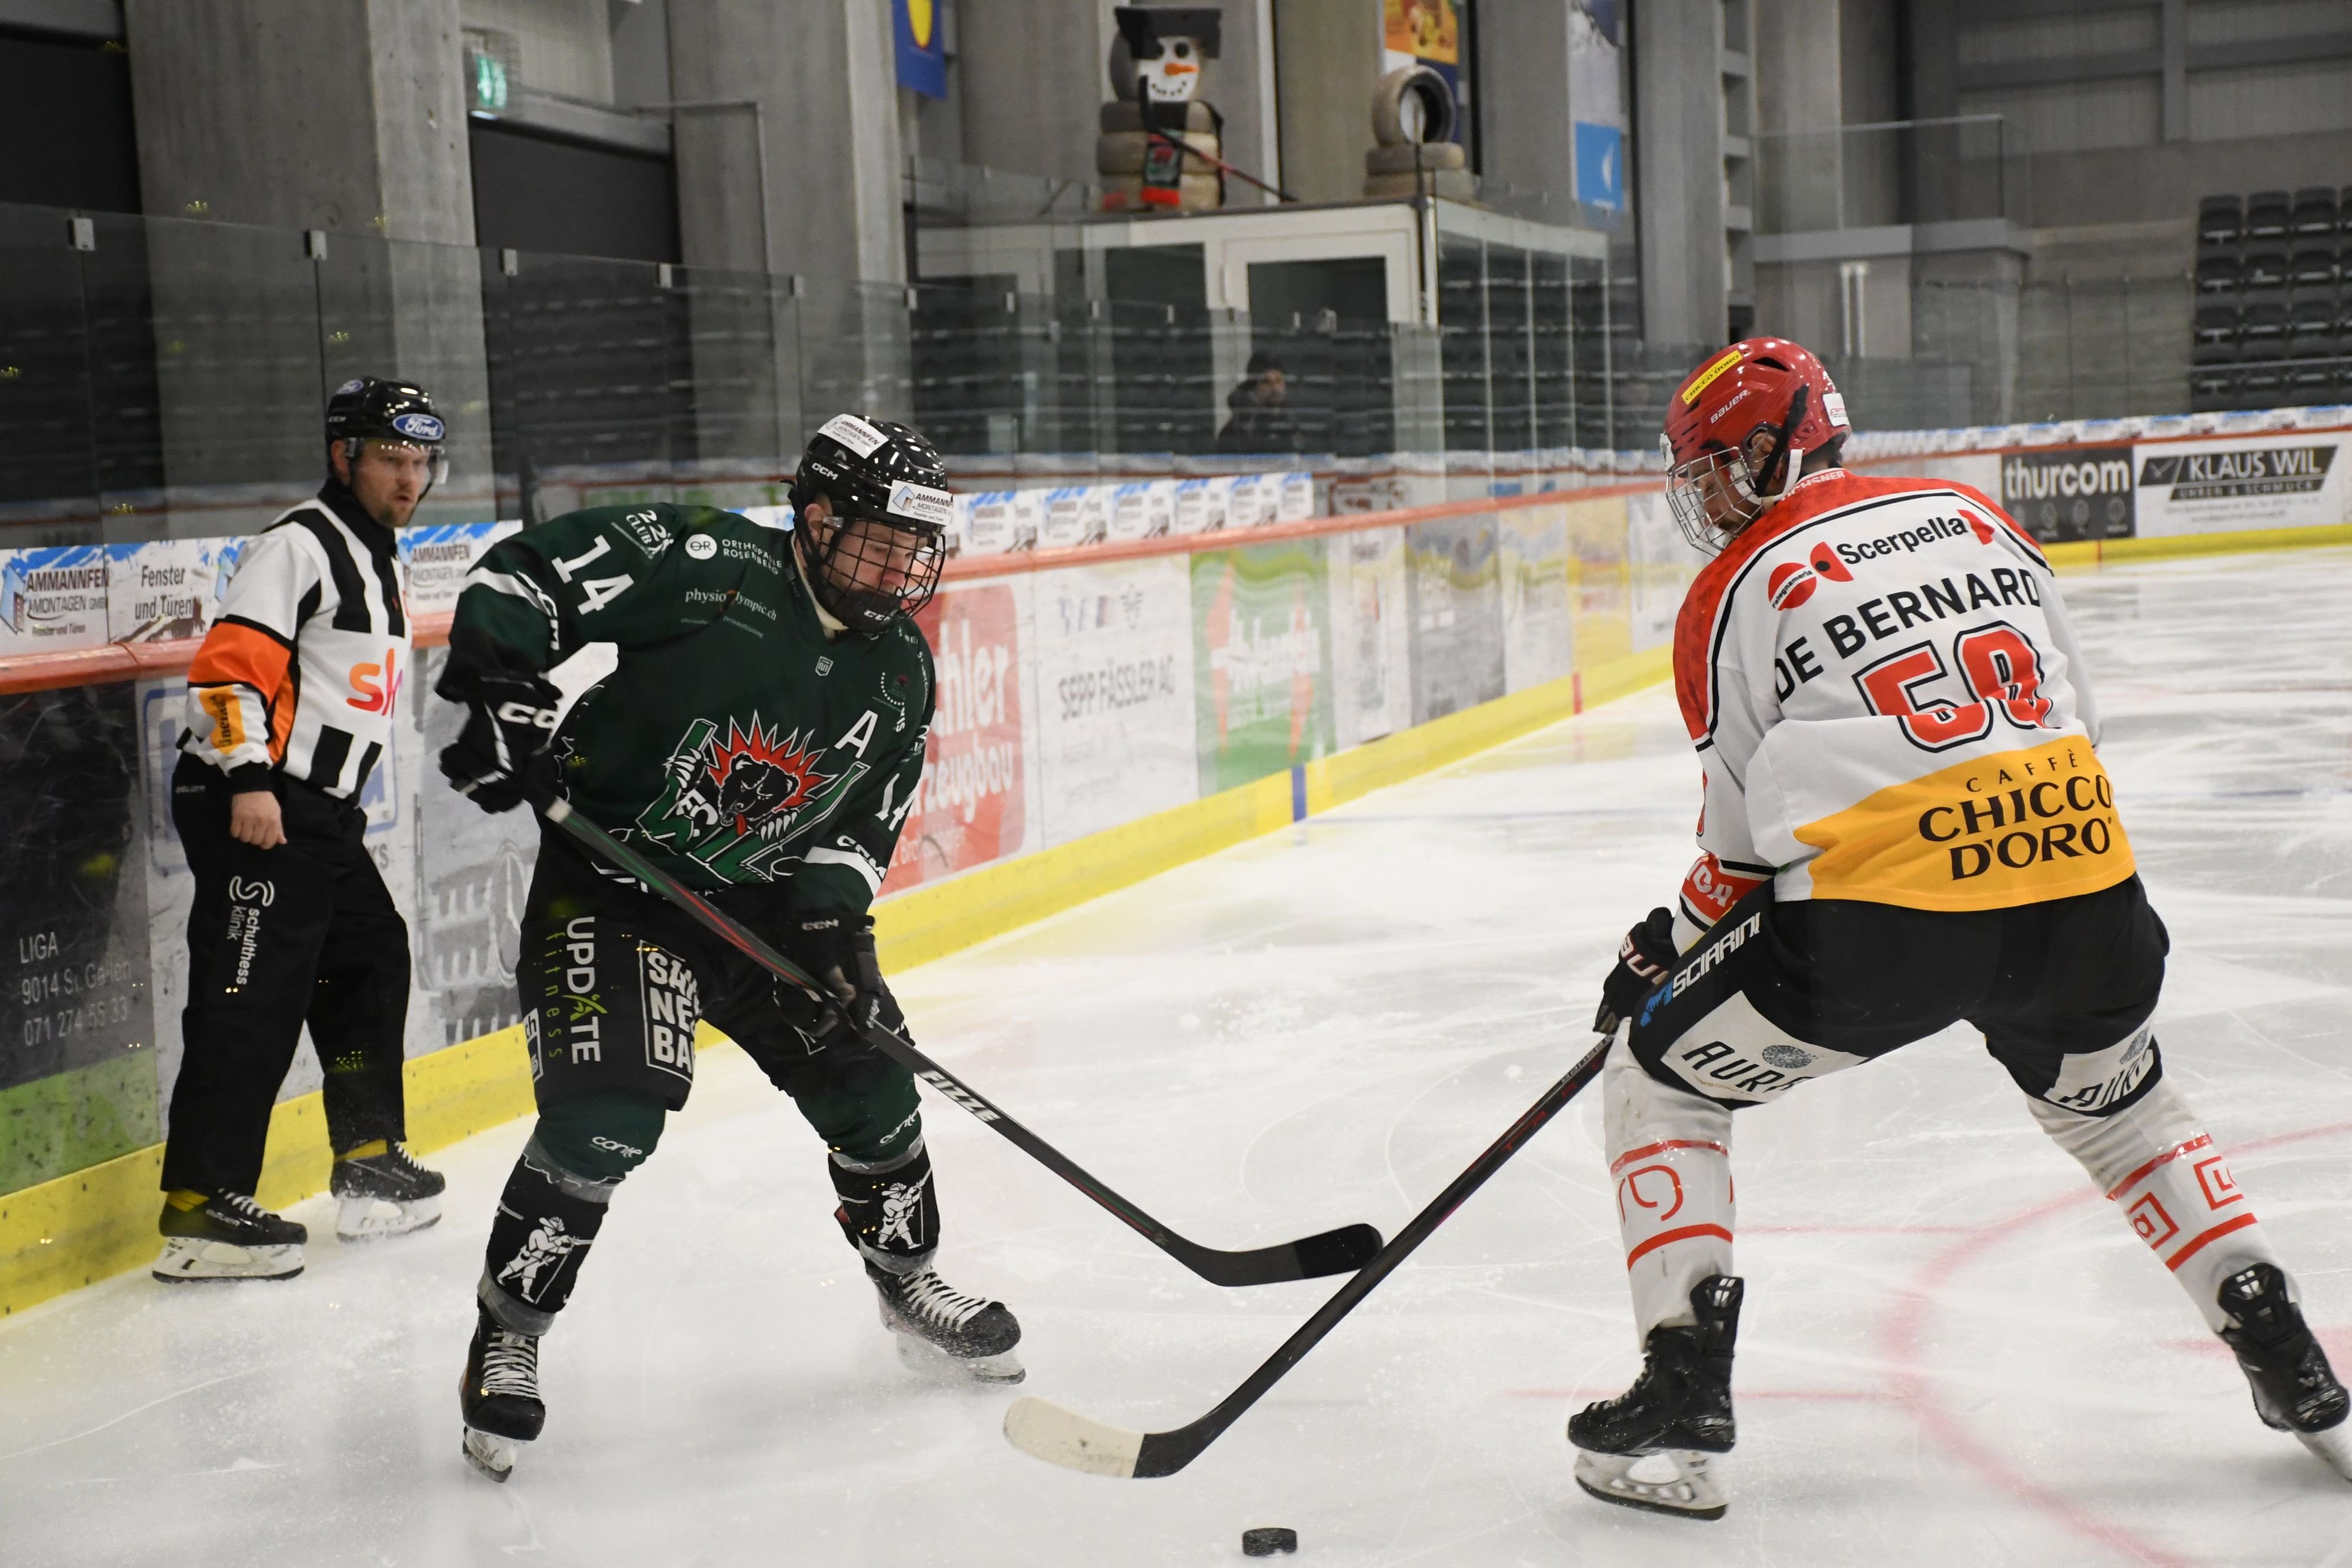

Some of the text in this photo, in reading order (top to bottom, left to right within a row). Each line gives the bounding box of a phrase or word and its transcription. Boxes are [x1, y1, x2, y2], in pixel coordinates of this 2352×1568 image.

[1685, 374, 1713, 400] CHICCO
[1710, 389, 1749, 424] BAUER
[405, 416, 437, 437] Ford
[811, 462, 839, 480] CCM
[2005, 457, 2130, 499] thurcom
[2189, 448, 2322, 481] KLAUS WIL
[626, 514, 652, 544] CLUB
[637, 509, 667, 541] 22
[1836, 516, 1969, 564] Scerpella
[141, 564, 185, 588] Fenster
[552, 534, 634, 616] 14
[1772, 570, 1813, 609] Falegnameria
[135, 594, 192, 618] und Türen
[1823, 567, 2041, 660] BERNARD
[1775, 636, 1824, 704] DE
[498, 701, 557, 730] CC
[834, 710, 878, 758] A
[1966, 748, 2078, 793] CAFFÈ
[1919, 774, 2112, 842] CHICCO
[1948, 817, 2110, 881] D'ORO
[226, 905, 247, 941] klinik
[19, 931, 58, 964] LIGA
[235, 907, 260, 985] schulthess
[1672, 912, 1761, 998] SCIARINI
[21, 972, 59, 1005] 9014
[544, 931, 566, 1058] fitness
[24, 1014, 51, 1047] 071
[916, 1070, 1001, 1122] FIZZE
